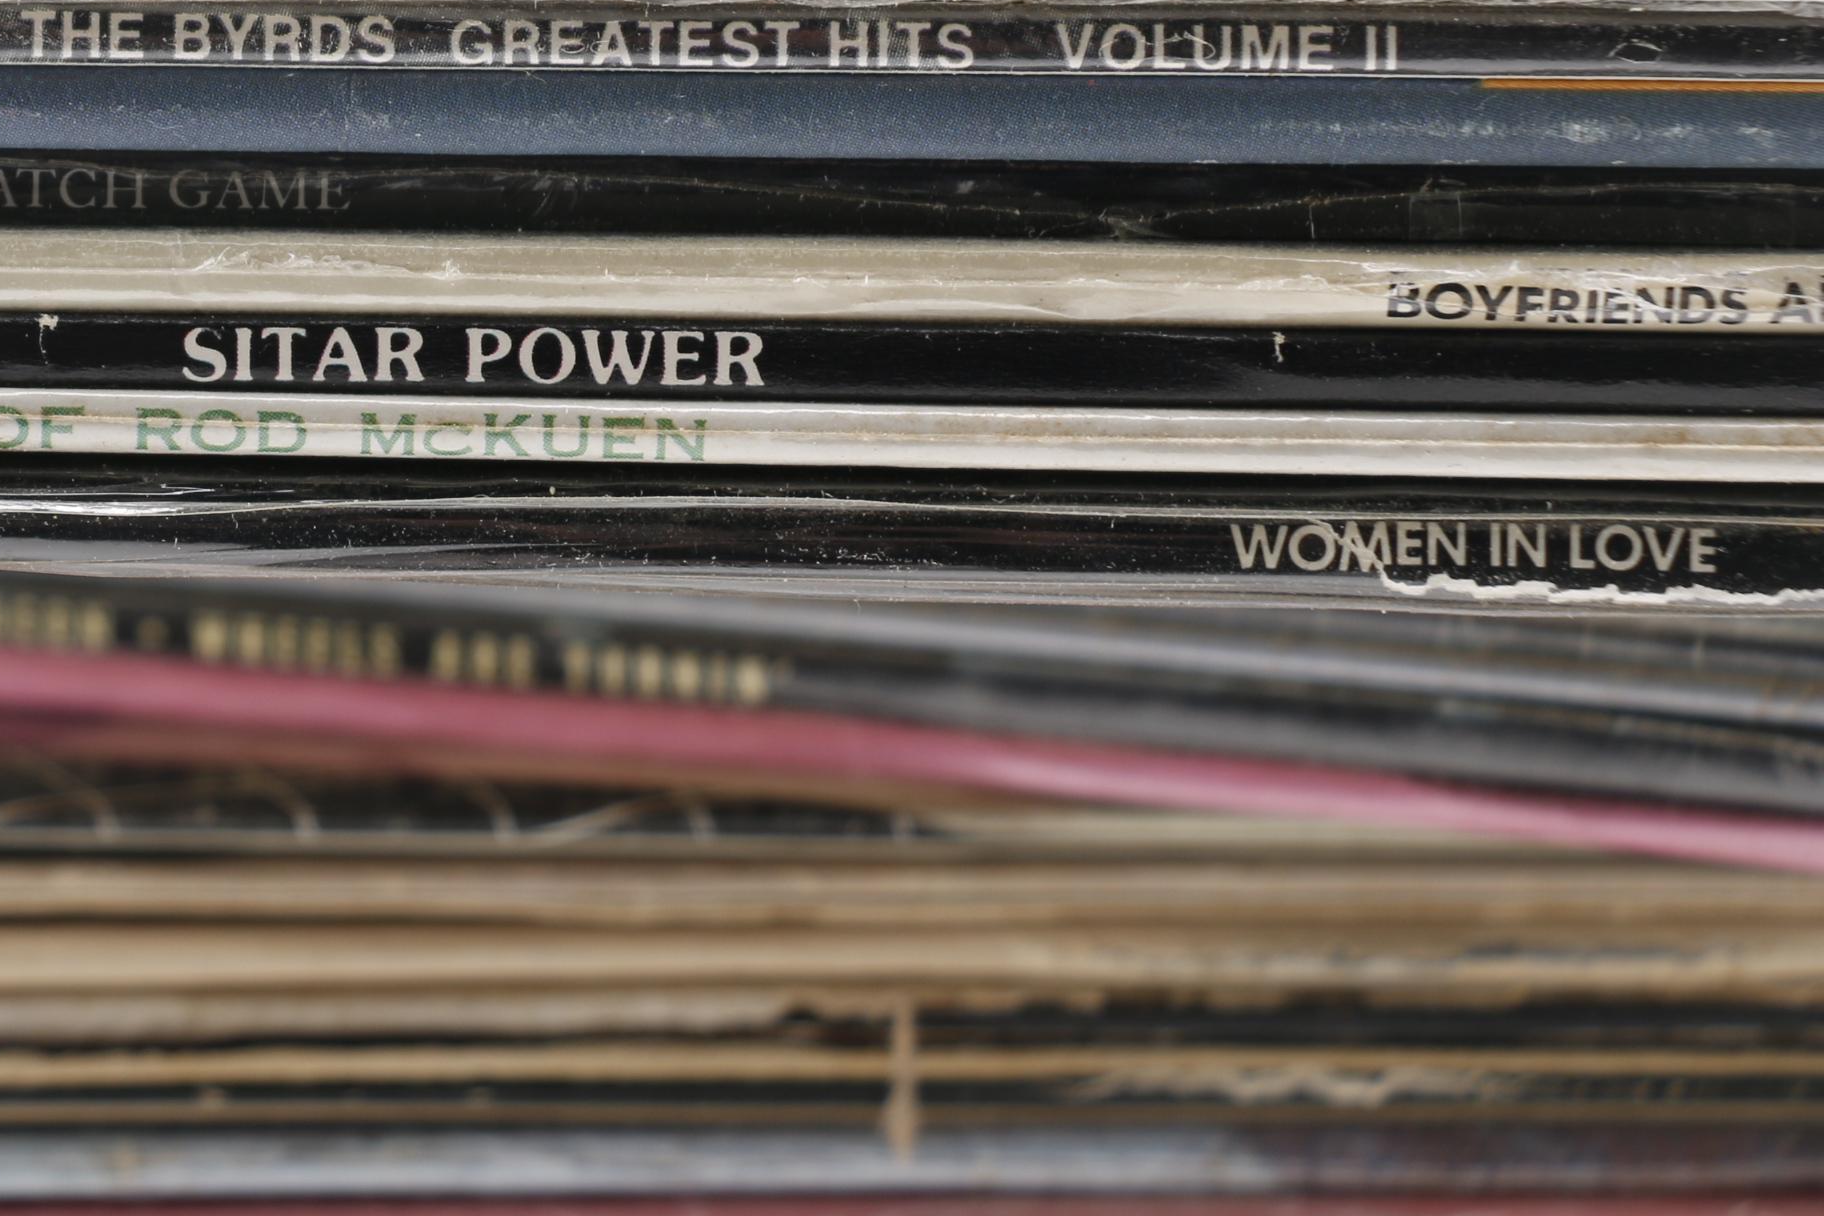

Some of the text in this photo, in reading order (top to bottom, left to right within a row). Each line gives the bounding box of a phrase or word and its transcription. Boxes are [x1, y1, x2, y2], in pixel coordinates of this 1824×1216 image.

[23, 10, 145, 59] THE
[174, 12, 396, 64] BYRDS
[450, 18, 1399, 71] GREATEST HITS VOLUME II
[168, 170, 352, 212] GAME
[1385, 274, 1824, 325] BOYFRIENDS A
[182, 327, 766, 388] SITAR POWER
[135, 407, 308, 453] ROD
[1231, 521, 1717, 573] WOMEN IN LOVE
